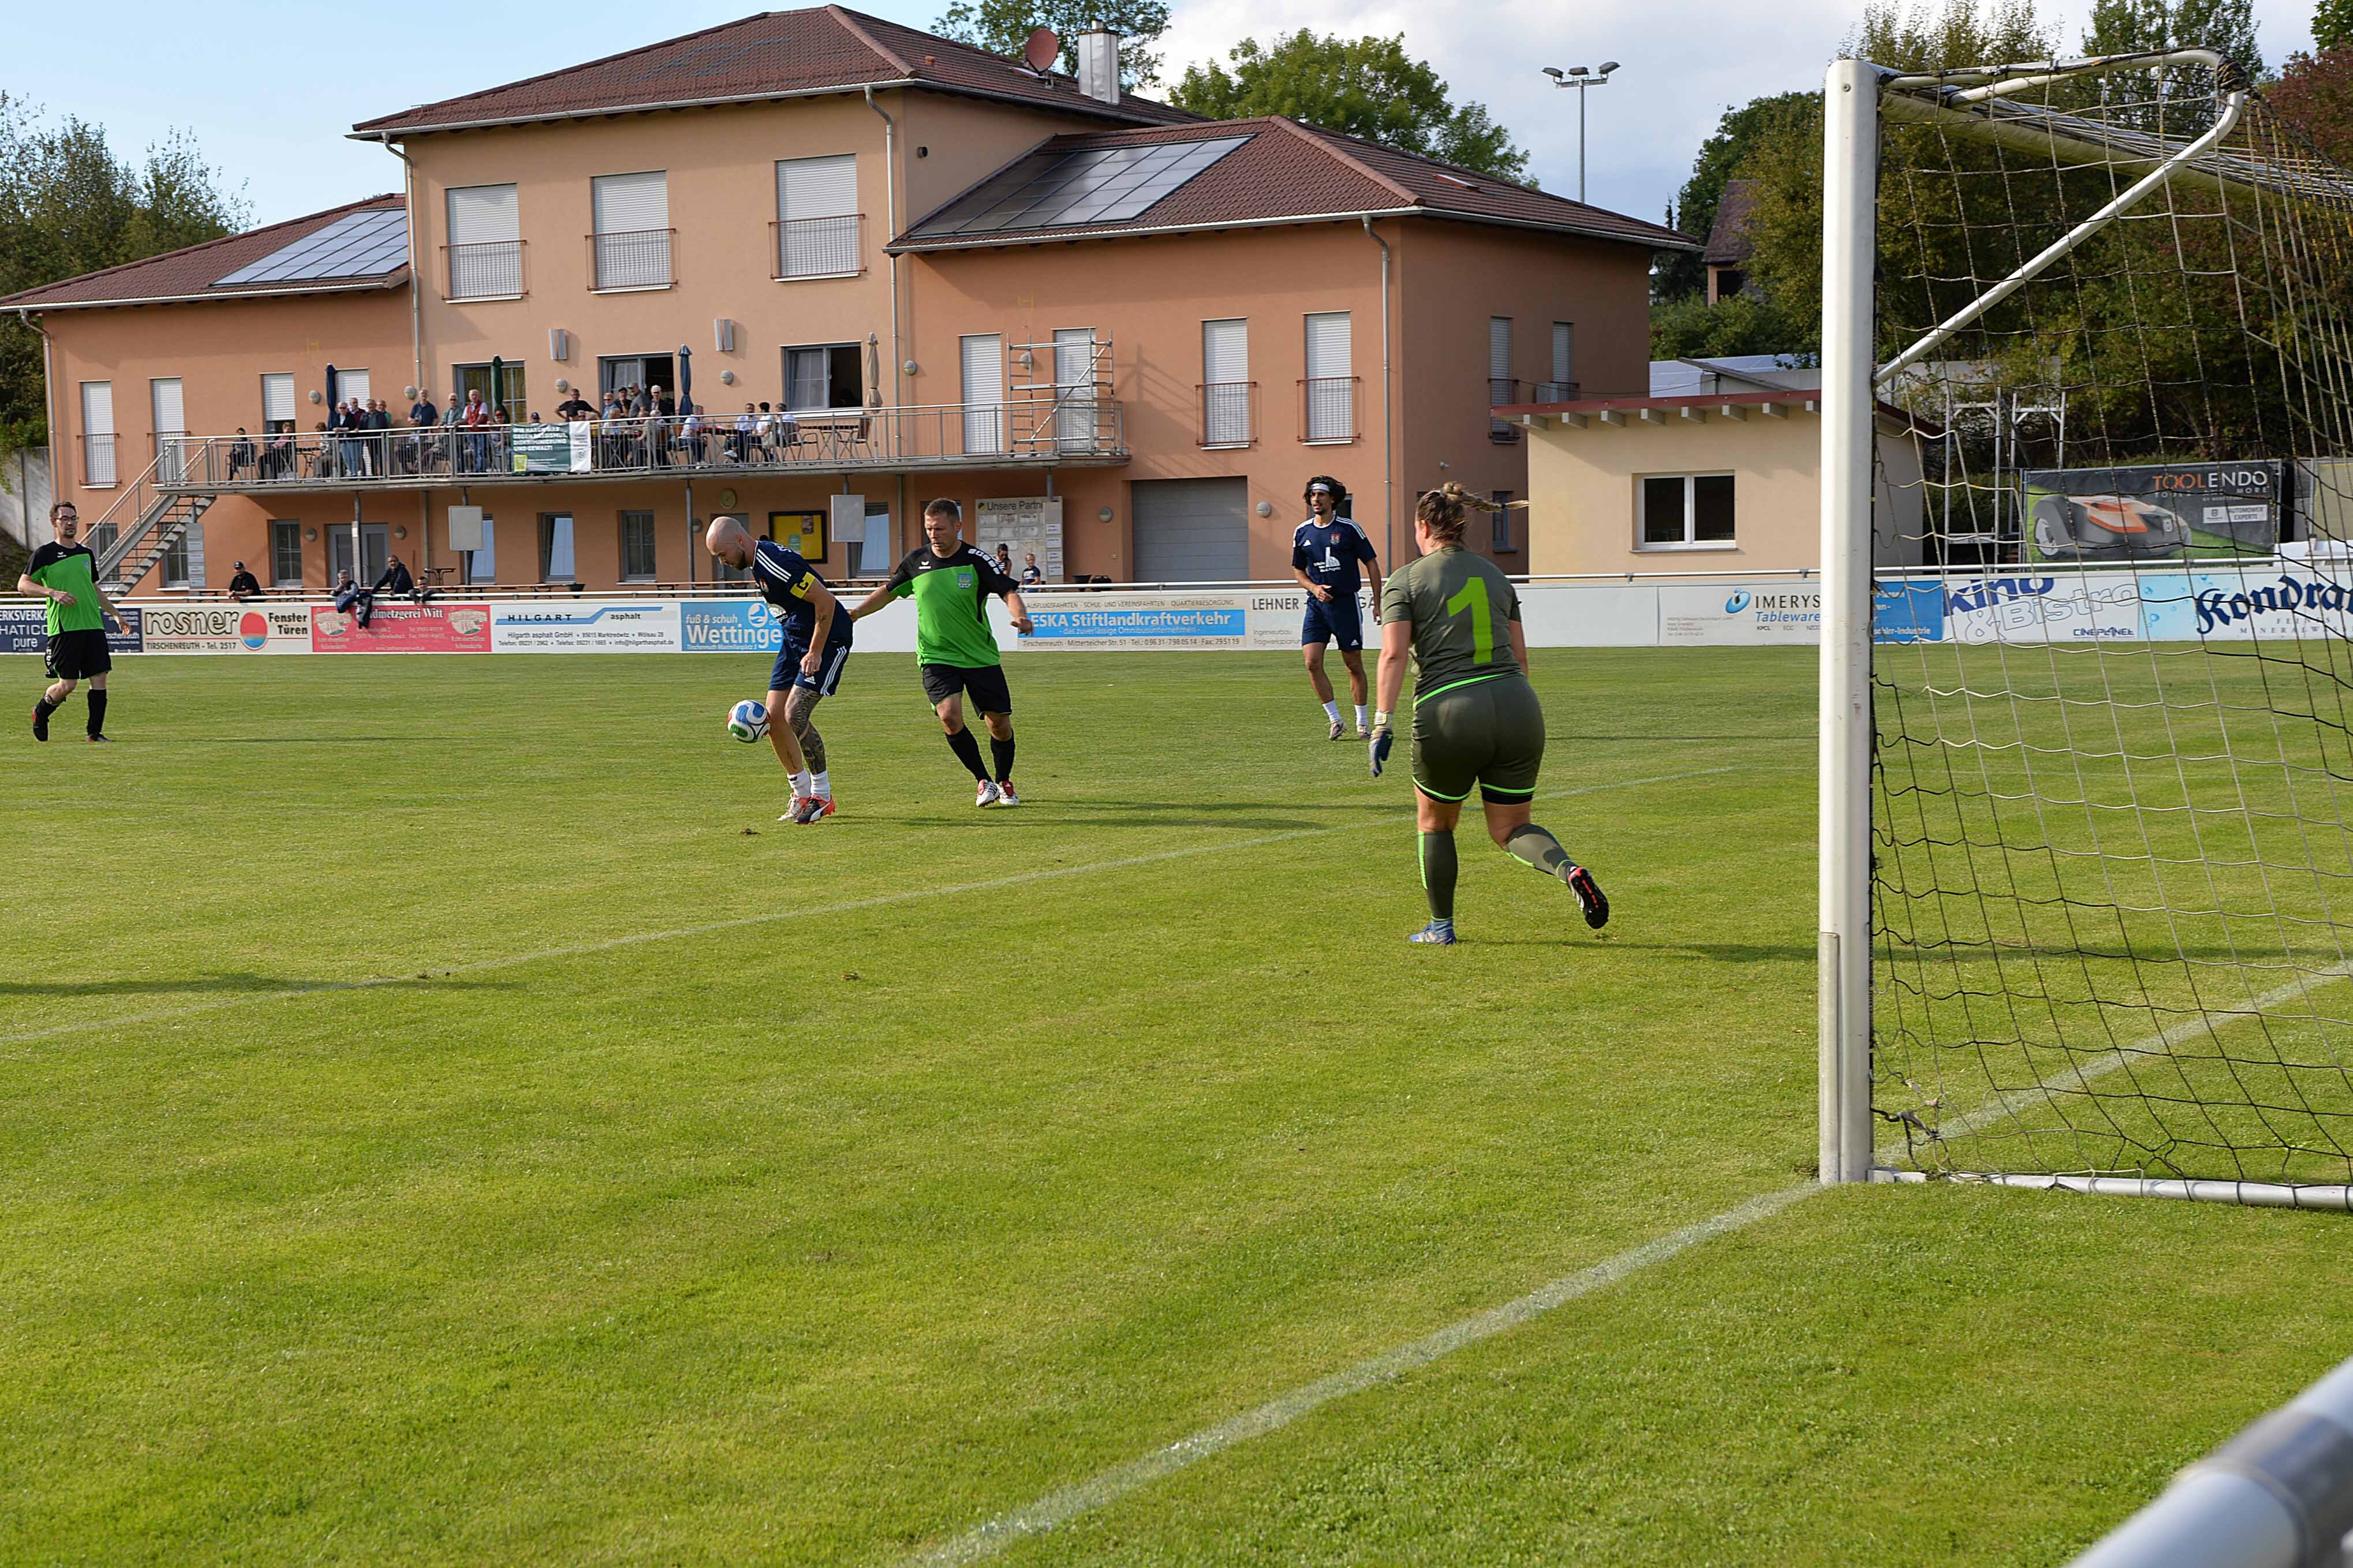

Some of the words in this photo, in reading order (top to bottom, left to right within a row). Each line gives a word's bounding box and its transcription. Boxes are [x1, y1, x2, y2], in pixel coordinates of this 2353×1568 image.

[2152, 470, 2268, 490] TOOLENDO
[988, 502, 1016, 511] Unsere
[1253, 598, 1299, 610] LEHNER
[1756, 594, 1820, 609] IMERYS
[2001, 583, 2138, 631] Bistro
[369, 608, 421, 621] dmetzgerei
[423, 608, 444, 618] Witt
[703, 614, 709, 623] &
[711, 614, 738, 623] schuh
[1071, 612, 1231, 627] Stiftlandkraftverkehr
[1447, 577, 1494, 664] 1
[1756, 611, 1820, 622] Tableware
[145, 611, 239, 635] rosner
[268, 612, 307, 623] Fenster
[278, 624, 308, 635] Türen
[13, 638, 38, 650] pure
